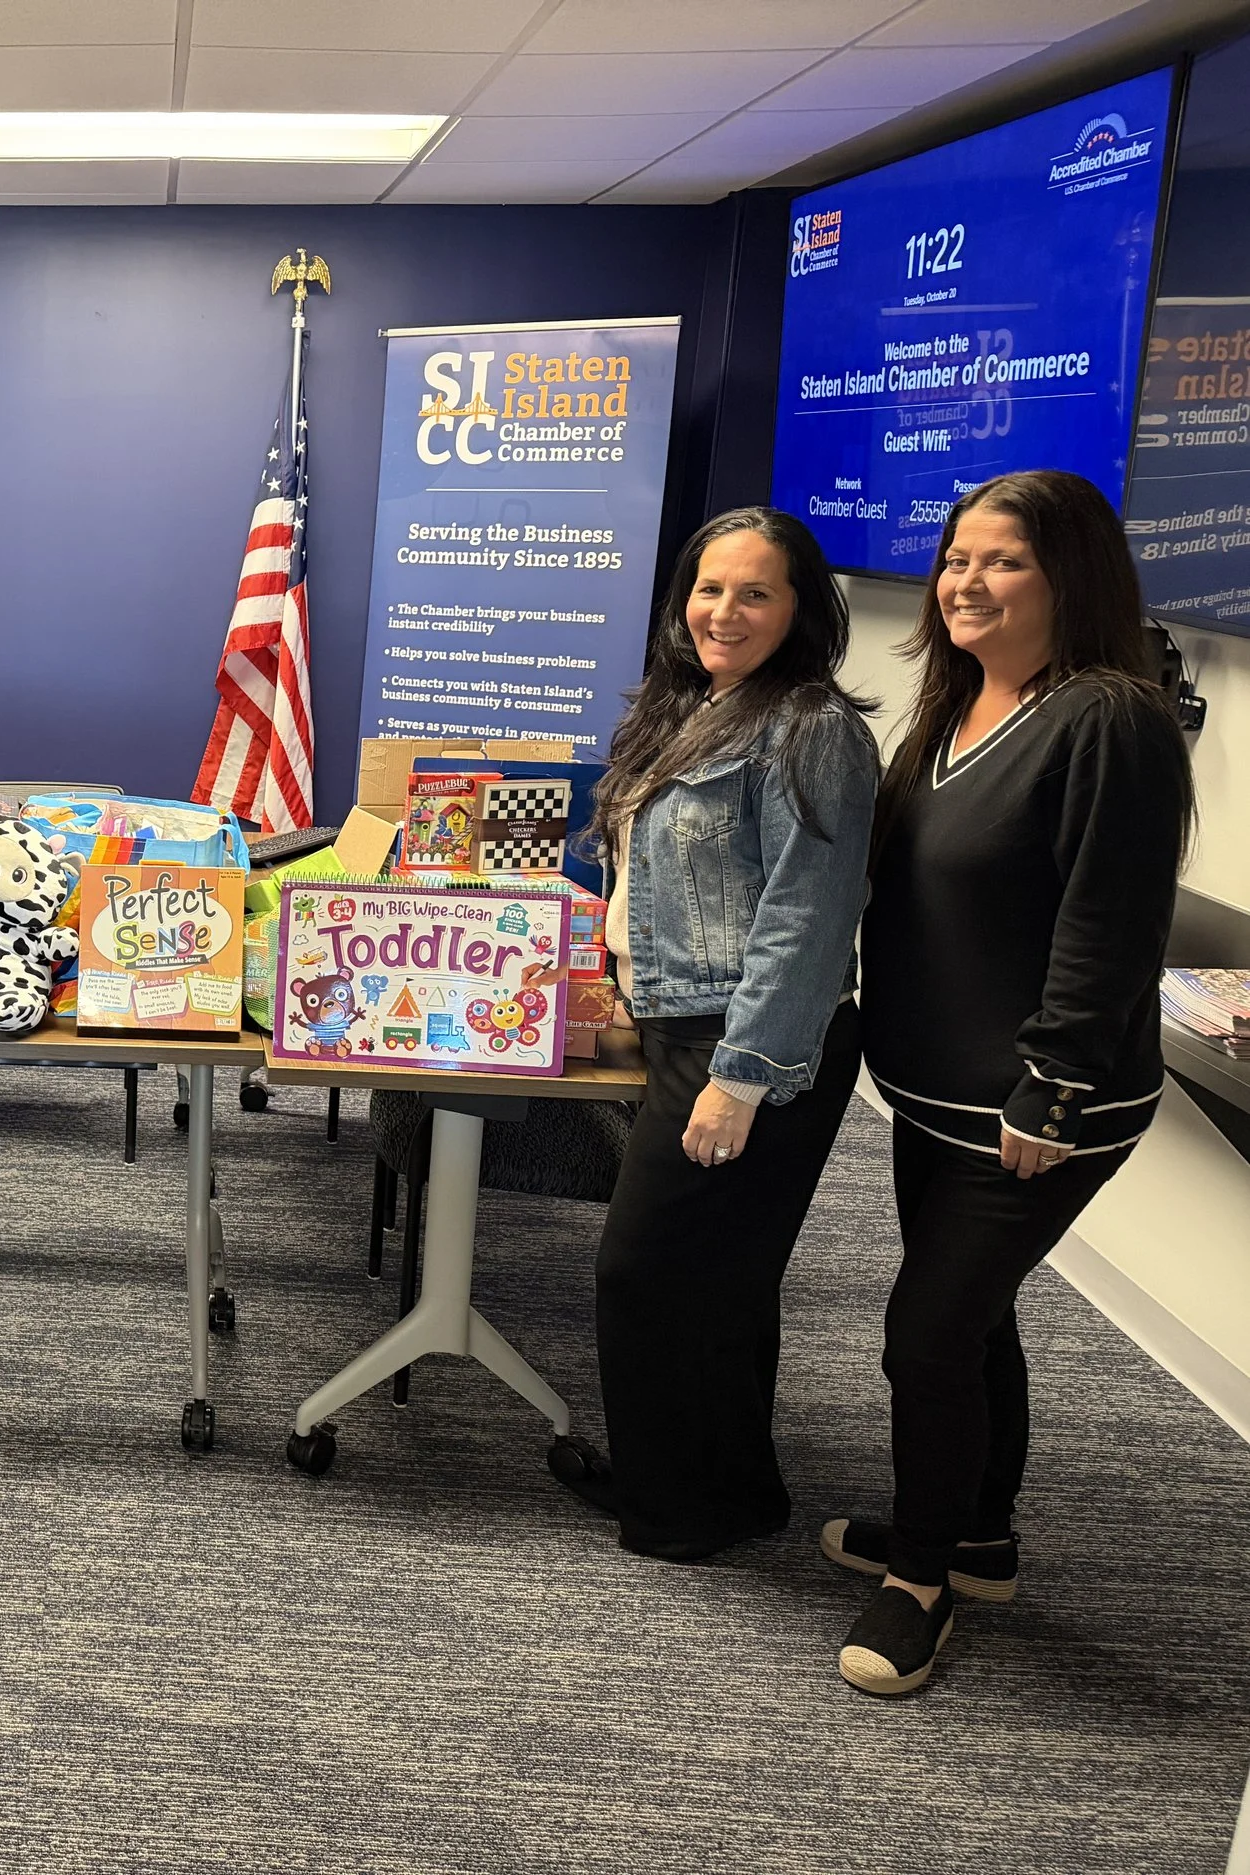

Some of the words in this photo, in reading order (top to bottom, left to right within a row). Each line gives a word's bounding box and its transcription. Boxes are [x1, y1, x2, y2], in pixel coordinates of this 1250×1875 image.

[1049, 151, 1103, 182] Accredited
[1103, 141, 1152, 167] Chamber
[793, 215, 812, 249] SI
[812, 210, 842, 231] Staten
[810, 224, 841, 249] Island
[791, 248, 810, 278] CC
[810, 247, 832, 262] Chamber
[832, 244, 840, 256] of
[906, 223, 965, 279] 11:22
[809, 257, 839, 272] Commerce
[903, 294, 926, 307] Tuesday,
[926, 289, 949, 303] October
[884, 340, 931, 362] Welcome
[934, 337, 946, 356] to
[949, 333, 969, 353] the
[504, 353, 631, 384] Staten
[800, 374, 841, 399] Staten
[844, 367, 885, 396] Island
[888, 361, 958, 392] Chamber
[961, 355, 982, 385] of
[984, 351, 1090, 384] Commerce
[421, 351, 495, 413] SI
[501, 383, 628, 418] Island
[416, 414, 495, 465] CC
[499, 423, 596, 442] Chamber
[600, 421, 627, 442] of
[884, 430, 920, 453] Guest
[922, 428, 951, 452] Wifi:
[498, 444, 625, 463] Commerce
[835, 477, 862, 490] Network
[810, 496, 854, 518] Chamber
[856, 499, 888, 520] Guest
[408, 523, 482, 545] Serving
[486, 525, 519, 542] the
[523, 525, 614, 545] Business
[397, 547, 510, 571] Community
[514, 549, 570, 568] Since
[573, 551, 622, 570] 1895
[397, 604, 418, 616] The
[420, 605, 475, 618] Chamber
[477, 606, 516, 623] brings
[518, 610, 547, 624] your
[550, 609, 606, 624] business
[388, 618, 429, 632] instant
[431, 619, 495, 636] credibility
[391, 646, 422, 662] Helps
[423, 650, 447, 664] you
[449, 648, 480, 662] solve
[482, 650, 536, 666] business
[537, 653, 597, 670] problems
[391, 675, 445, 690] Connects
[446, 680, 469, 693] you
[470, 678, 498, 692] with
[500, 682, 542, 697] Staten
[544, 684, 594, 700] Island's
[381, 687, 431, 703] business
[432, 692, 502, 710] community
[503, 694, 513, 707] &
[514, 697, 583, 714] consumers
[387, 717, 425, 731] Serves
[426, 721, 440, 732] as
[441, 724, 470, 736] your
[471, 725, 503, 738] voice
[505, 726, 518, 739] in
[520, 730, 598, 746] government
[103, 873, 217, 924] Perfect
[386, 901, 411, 915] BIG
[414, 901, 492, 921] Wipe-Clean
[135, 957, 156, 967] Riddles
[156, 956, 168, 965] That
[169, 956, 184, 965] Make
[185, 955, 202, 964] Sense
[317, 923, 523, 977] Toddler
